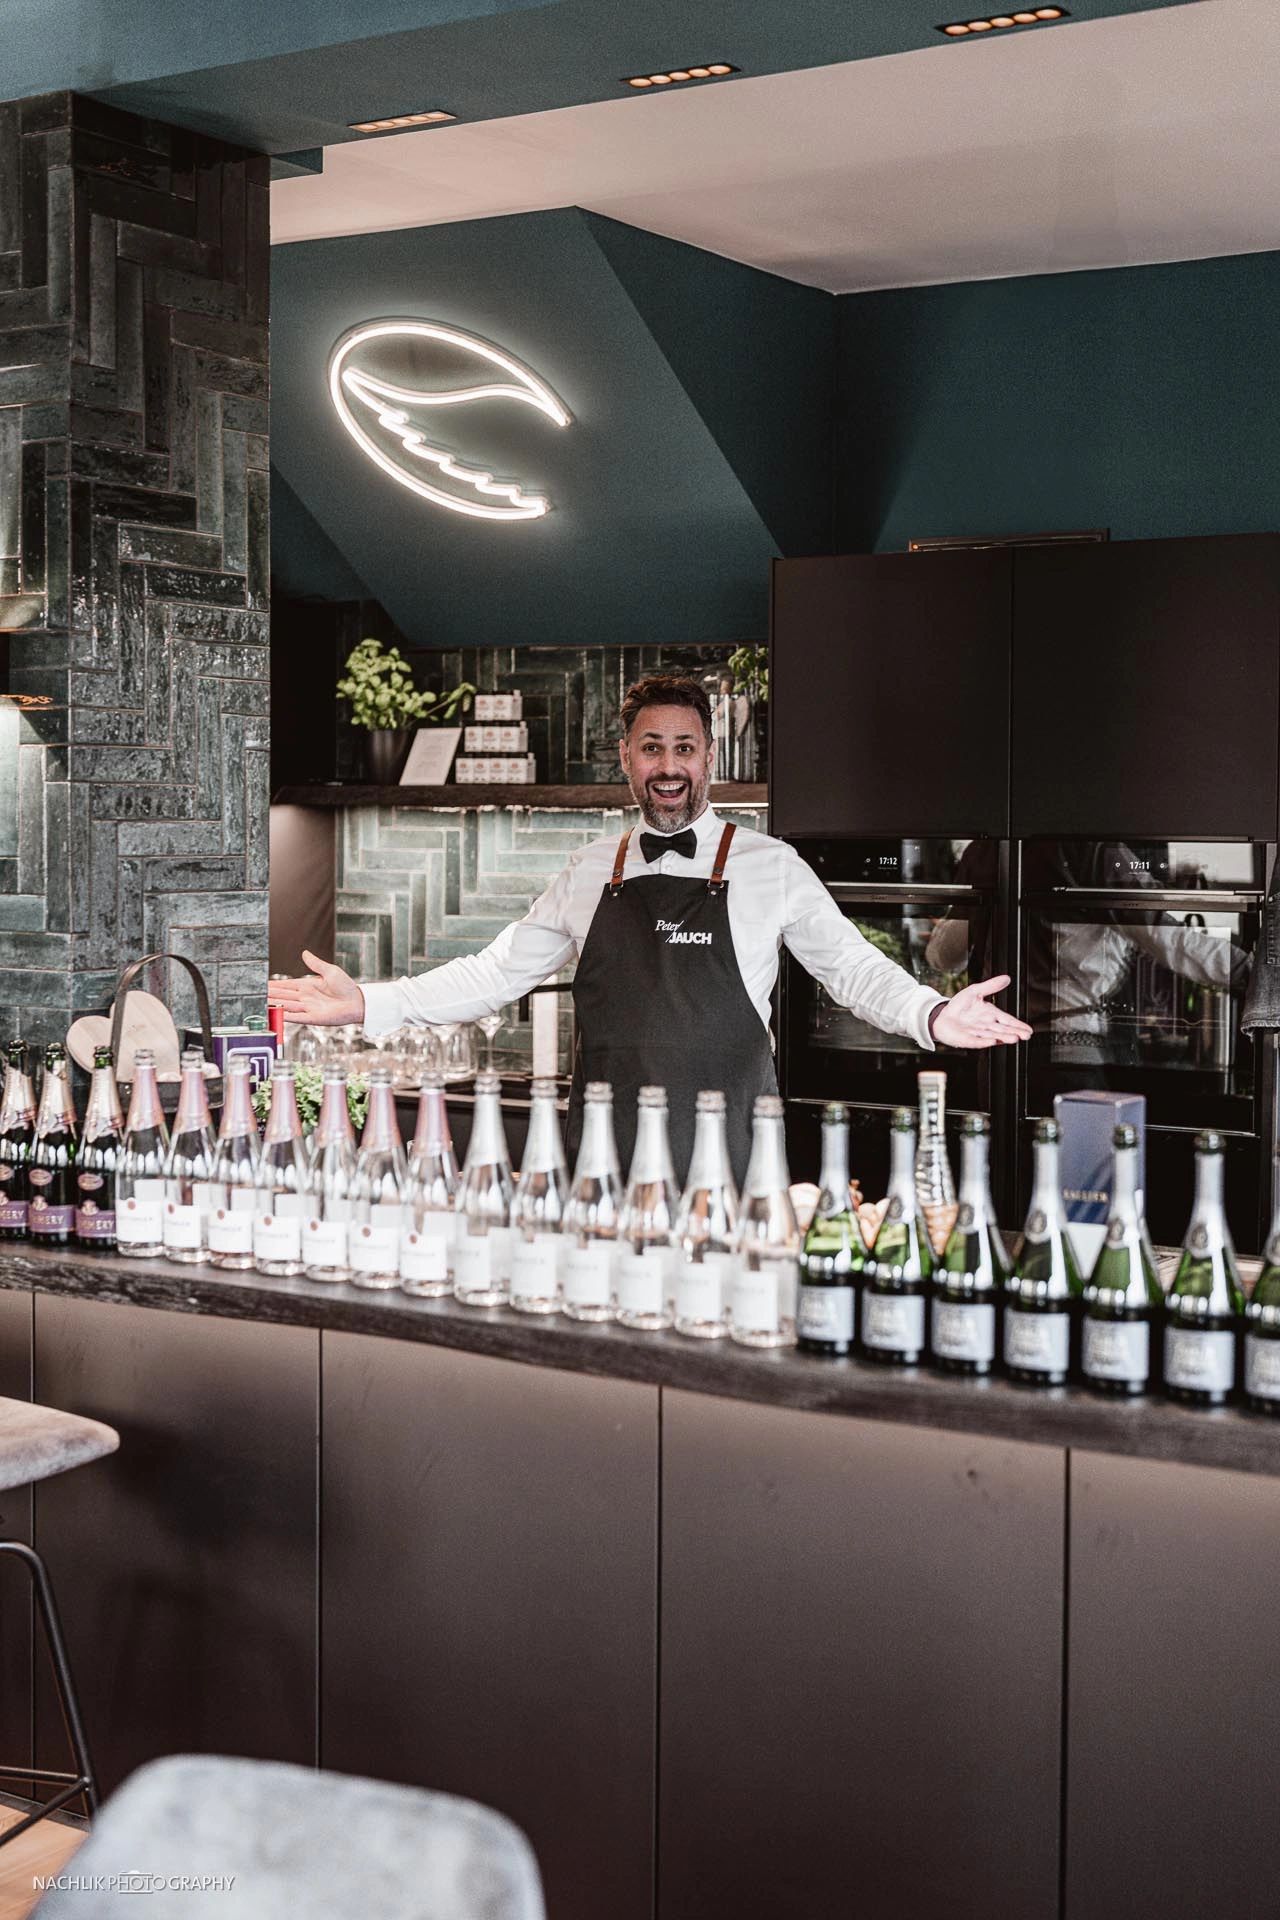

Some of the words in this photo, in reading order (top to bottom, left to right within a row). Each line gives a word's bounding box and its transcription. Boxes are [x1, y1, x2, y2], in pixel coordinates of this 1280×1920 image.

[879, 856, 898, 865] 17:12
[1129, 861, 1150, 870] 17:11
[654, 919, 682, 932] Peter
[668, 932, 712, 945] JAUCH
